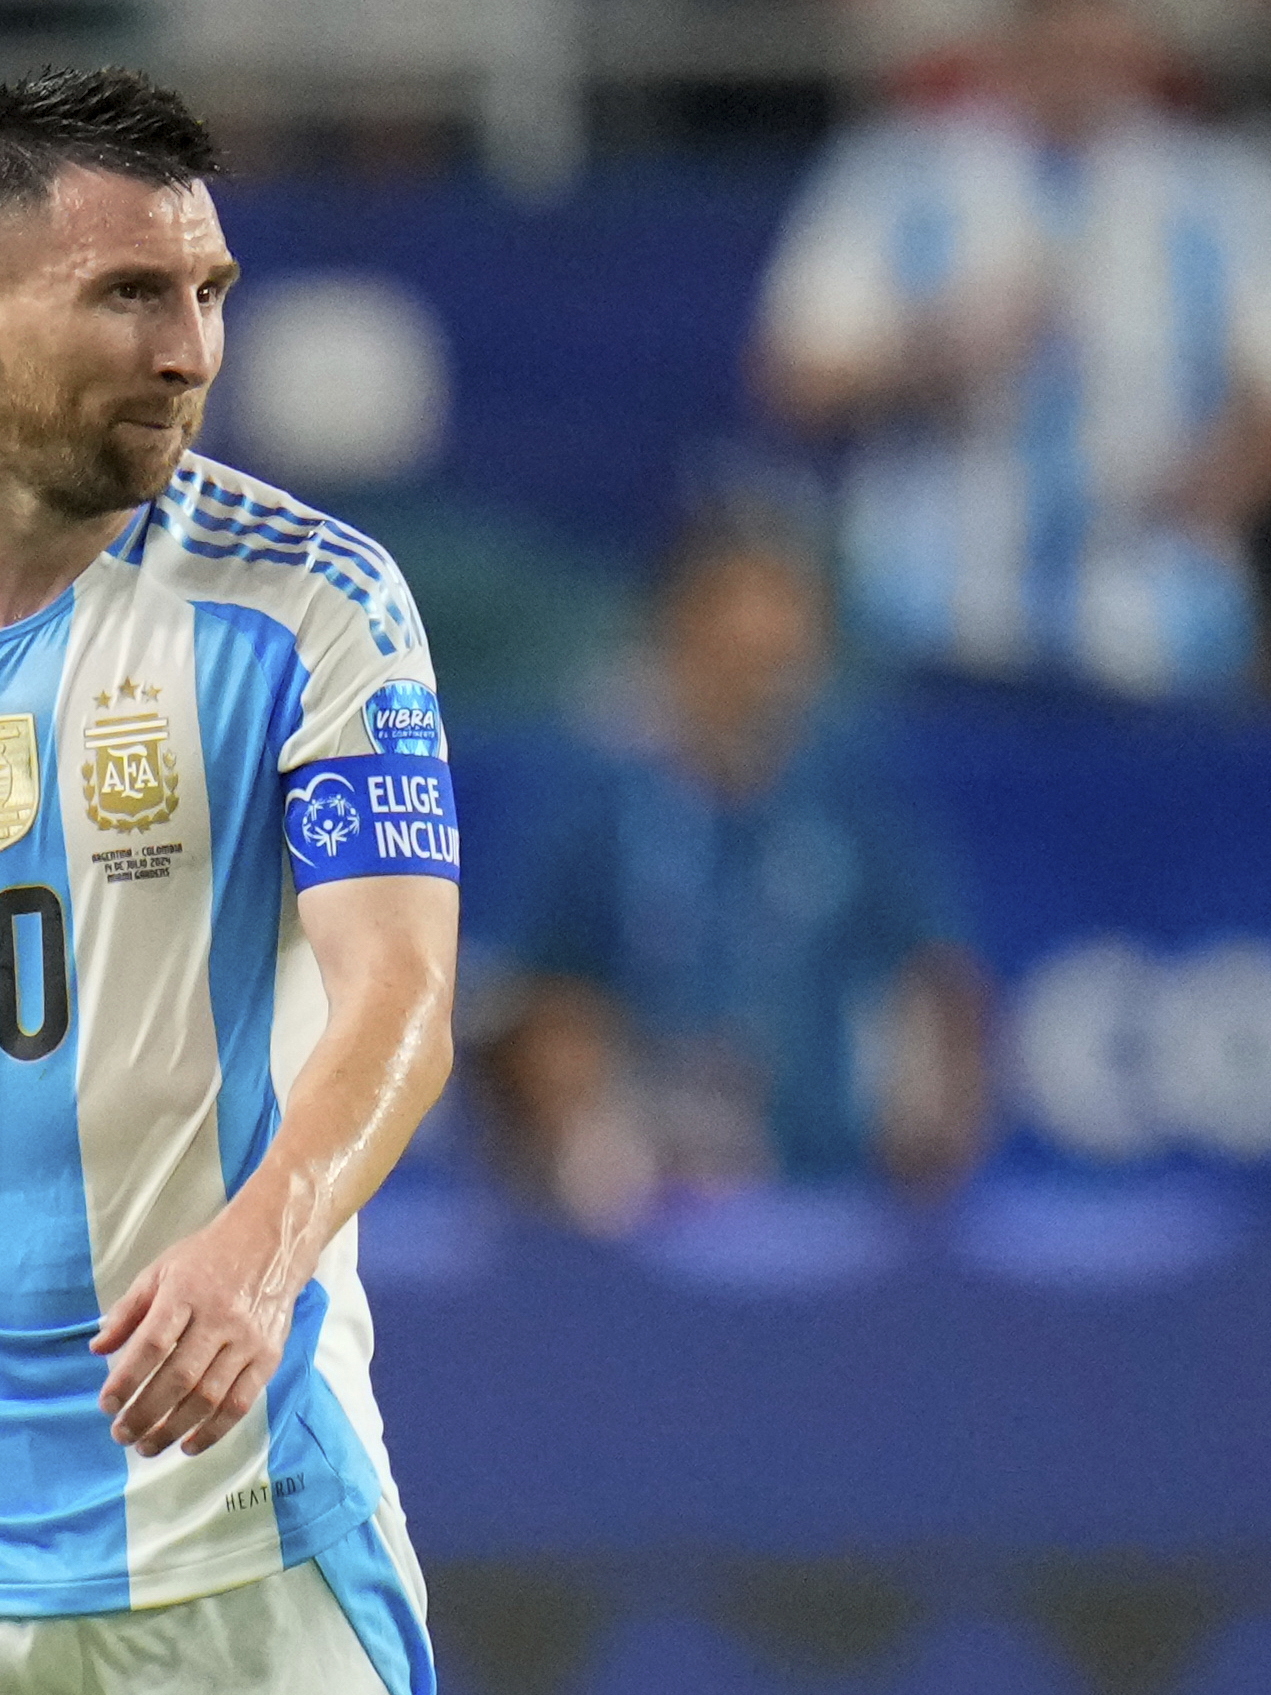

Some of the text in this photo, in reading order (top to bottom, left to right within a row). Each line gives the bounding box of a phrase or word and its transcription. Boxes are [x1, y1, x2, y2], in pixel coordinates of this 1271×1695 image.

[376, 709, 434, 729] VIBRA
[101, 744, 158, 799] AFA
[367, 775, 443, 816] ELIGE
[374, 820, 460, 867] INCLUI
